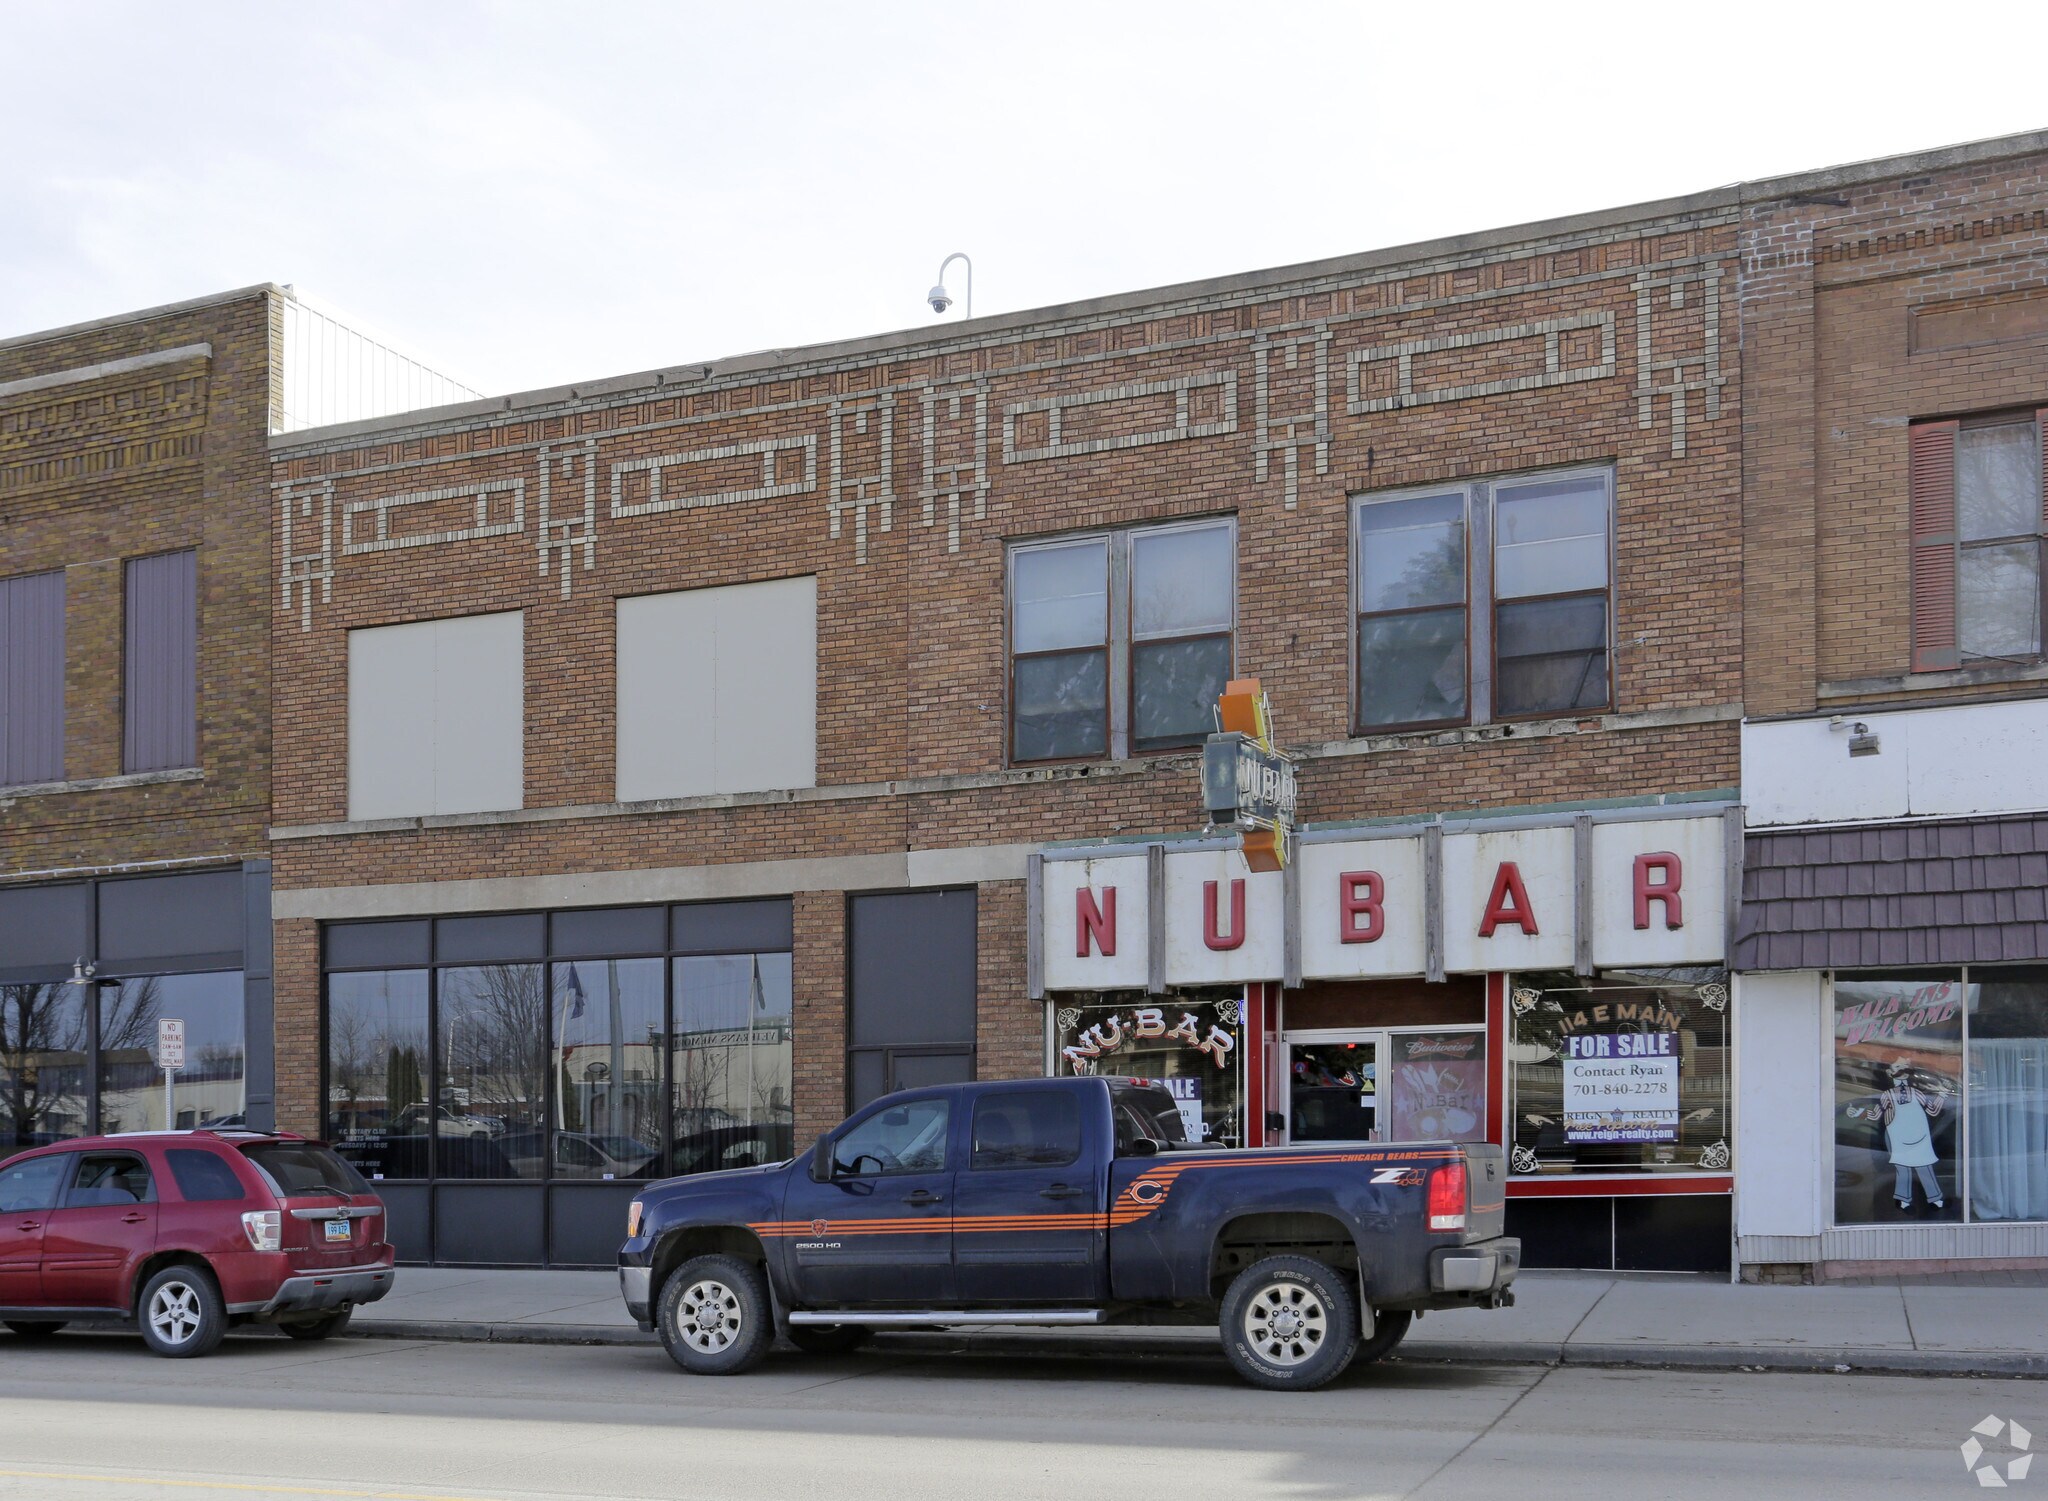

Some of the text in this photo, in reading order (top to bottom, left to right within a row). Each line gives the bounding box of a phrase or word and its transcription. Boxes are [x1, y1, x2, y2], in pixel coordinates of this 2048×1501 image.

[1910, 980, 1954, 1009] INS
[1558, 1003, 1682, 1034] 114 E MAIN
[1844, 1000, 1957, 1047] WELCOME
[167, 1023, 176, 1031] NO
[162, 1034, 182, 1042] PARKING
[1405, 1041, 1475, 1054] Budweiser
[1570, 1034, 1670, 1057] FOR SALE
[1574, 1064, 1663, 1079] Contact Ryan
[1163, 1078, 1195, 1098] ALE
[1573, 1082, 1668, 1096] 701-840-2278
[1567, 1110, 1674, 1120] REIGN REALTY
[1568, 1129, 1674, 1140] www.reign-realty.com
[1341, 1152, 1420, 1162] CHICAGO BEARS
[328, 1226, 337, 1235] 199
[1273, 1270, 1336, 1311] TERRA TRAC
[1235, 1342, 1294, 1379] HERCULES
